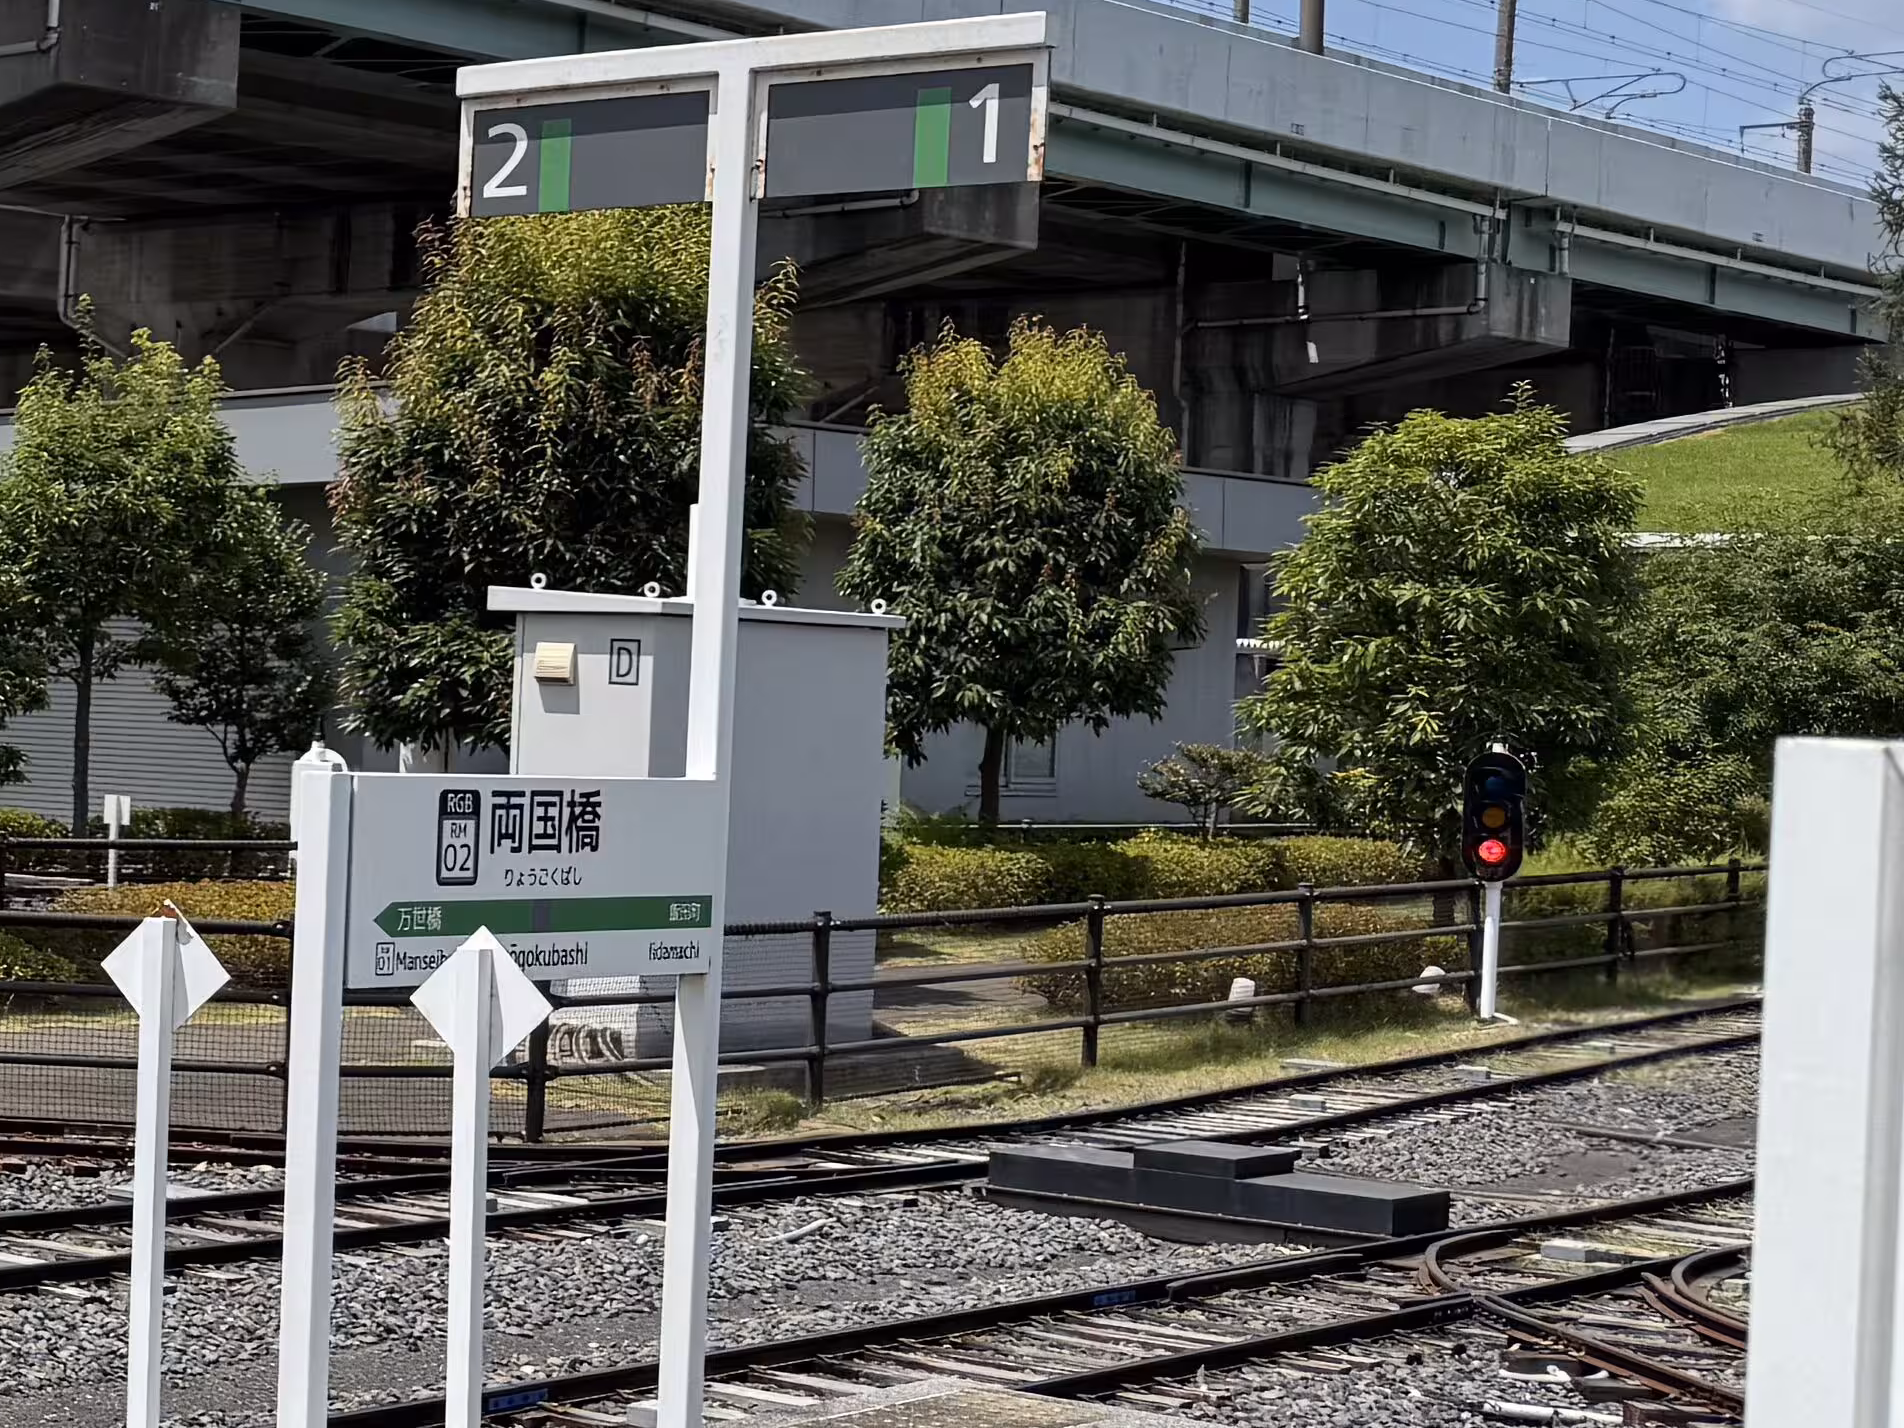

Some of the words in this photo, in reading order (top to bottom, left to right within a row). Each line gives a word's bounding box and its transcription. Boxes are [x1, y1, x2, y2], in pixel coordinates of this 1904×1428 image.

[968, 82, 1000, 164] 1
[482, 122, 528, 199] 2
[616, 647, 633, 678] D
[447, 794, 473, 812] RGB
[490, 789, 601, 855] 両国橋
[443, 844, 471, 872] 02
[397, 906, 442, 931] 万世橋
[396, 949, 448, 971] Manseib
